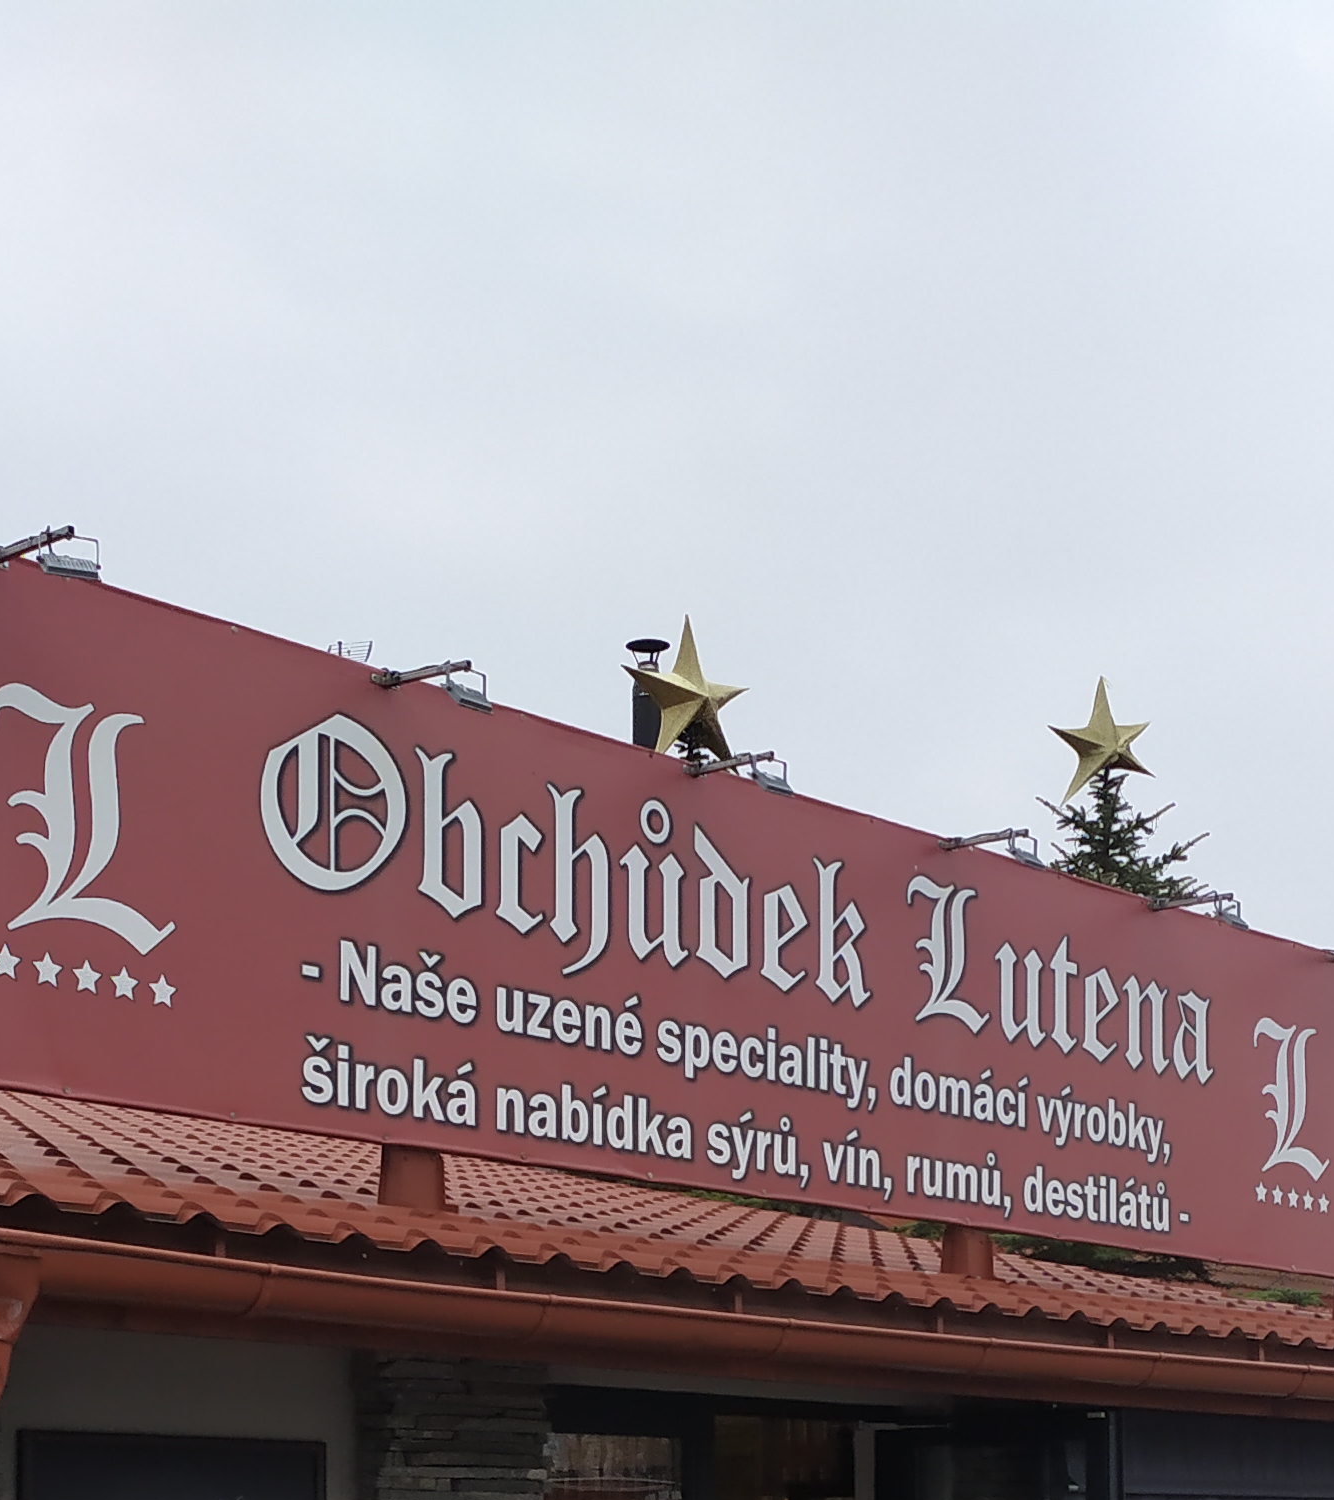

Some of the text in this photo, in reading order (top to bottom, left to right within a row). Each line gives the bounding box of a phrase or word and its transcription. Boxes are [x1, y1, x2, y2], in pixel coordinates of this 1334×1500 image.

[260, 713, 1215, 1087] Obchůdek Lutena
[301, 1035, 477, 1128] široká
[496, 1082, 693, 1160] nabídka
[706, 1110, 811, 1188] sýrů,
[822, 1130, 894, 1202] vín,
[905, 1152, 1013, 1217] rumů,
[1022, 1165, 1171, 1234] destilátů
[339, 939, 478, 1026] Naše
[496, 986, 642, 1057] uzené
[656, 1017, 877, 1112] speciality,
[889, 1056, 1027, 1129] domácí
[1037, 1084, 1173, 1166] výrobky,
[1253, 1017, 1330, 1183] L
